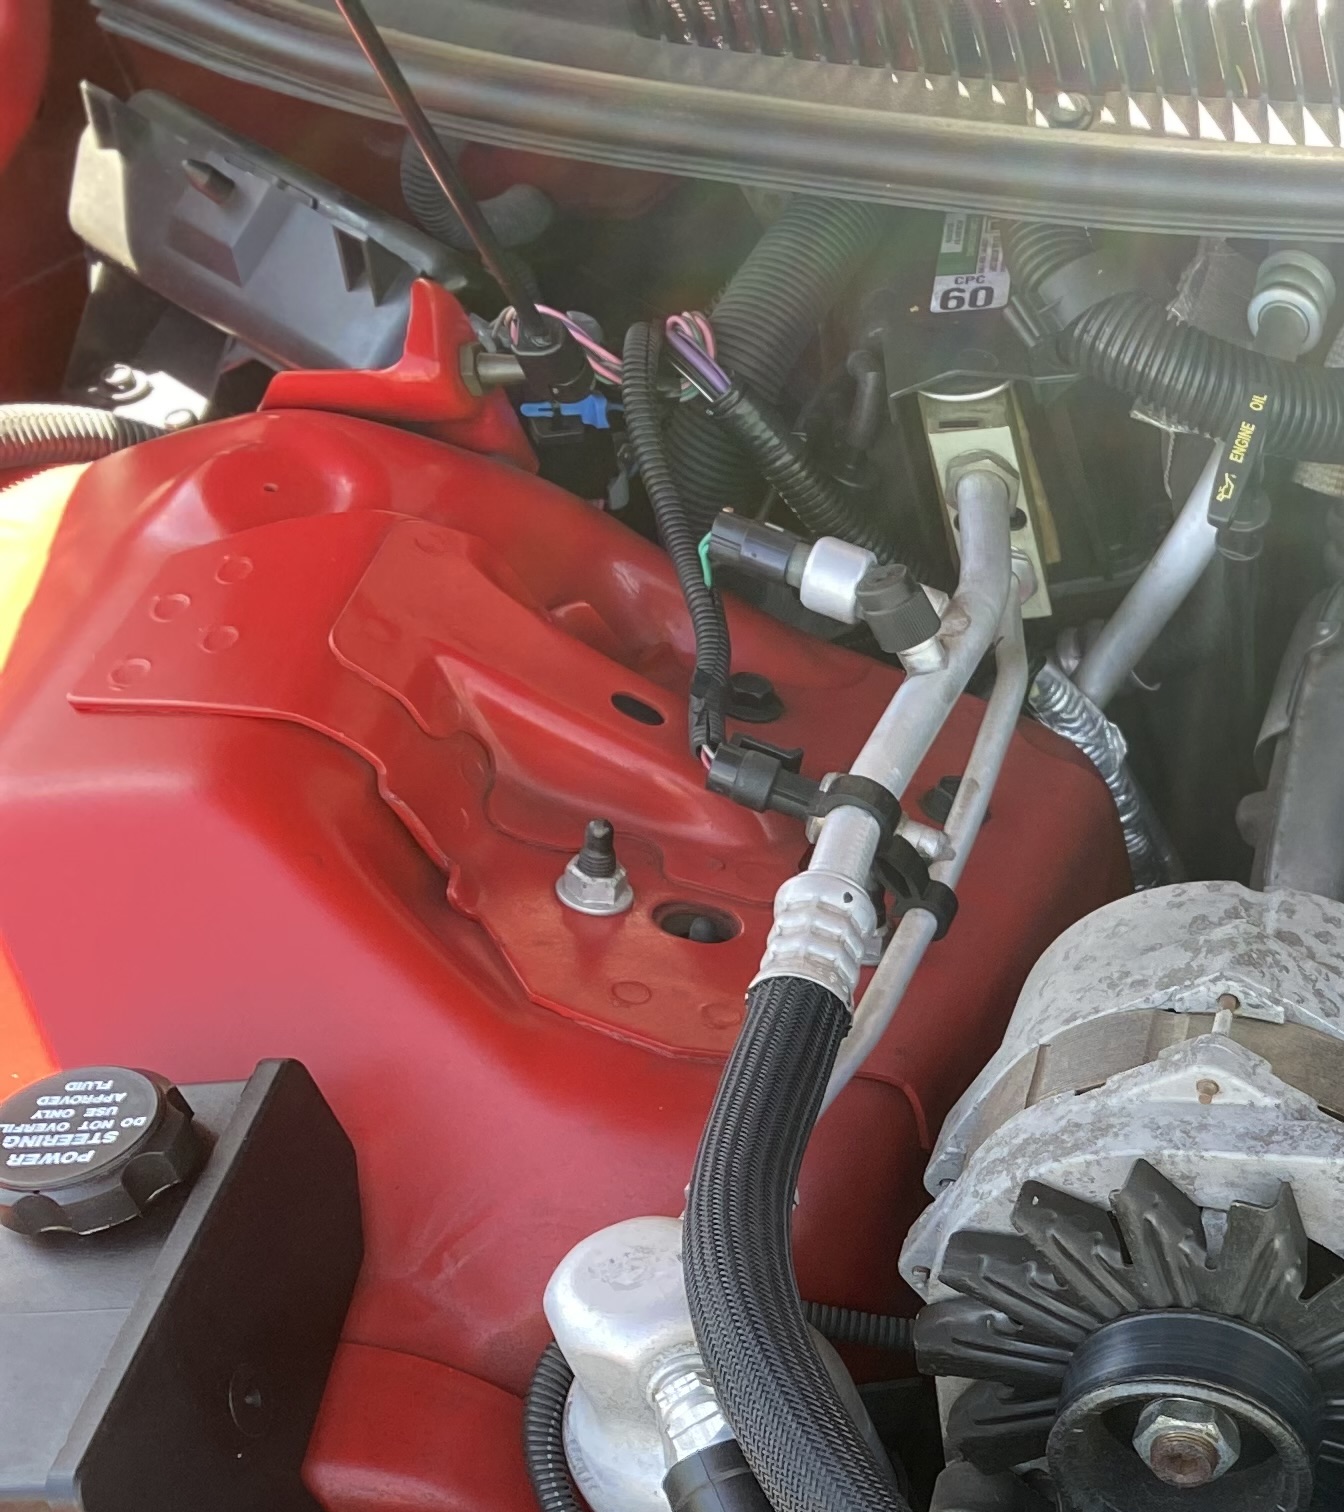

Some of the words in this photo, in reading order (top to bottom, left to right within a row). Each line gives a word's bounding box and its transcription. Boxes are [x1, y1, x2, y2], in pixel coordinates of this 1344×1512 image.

[954, 275, 986, 285] CPC
[939, 286, 995, 310] 60
[1228, 421, 1256, 463] ENGINE
[1249, 393, 1268, 412] OIL
[65, 1080, 114, 1091] FLUID
[36, 1092, 127, 1106] APPROVED
[30, 1108, 76, 1119] ONLY
[83, 1106, 119, 1117] USE
[77, 1119, 115, 1131] NOT
[120, 1117, 147, 1127] DO
[2, 1131, 119, 1149] STEERING
[6, 1150, 96, 1167] POWER
